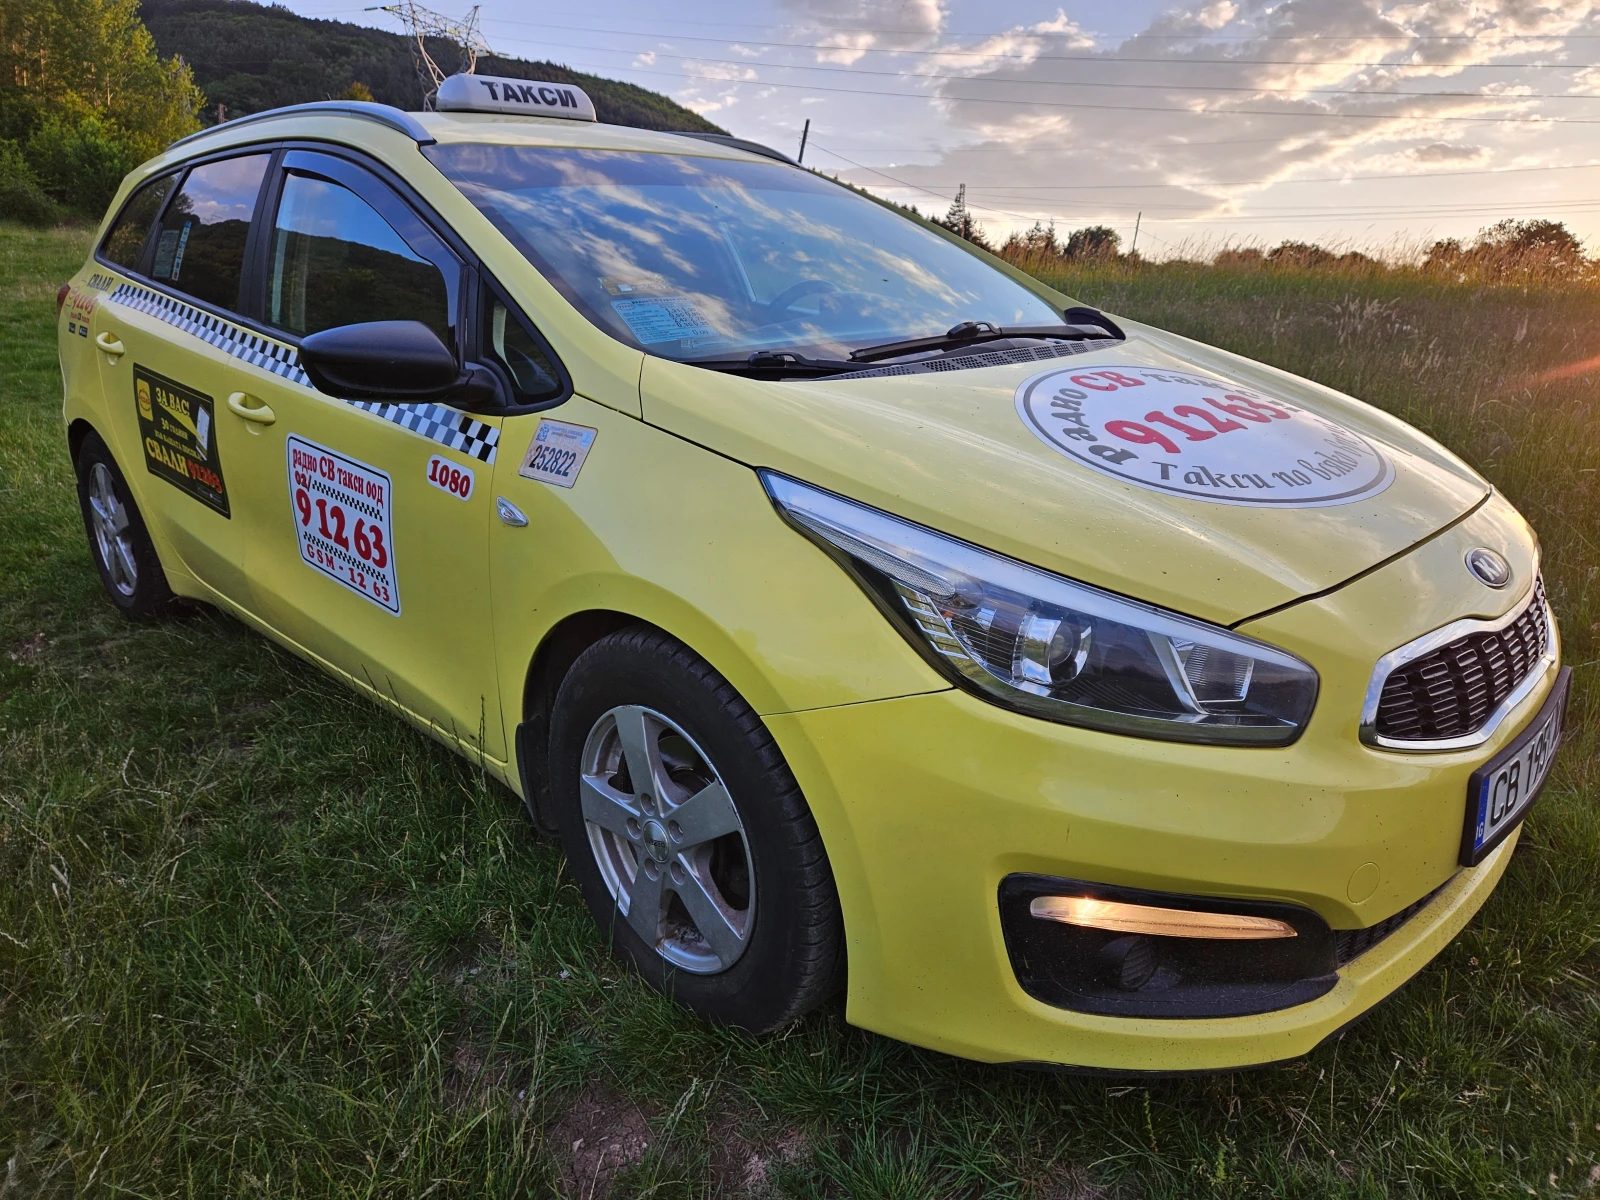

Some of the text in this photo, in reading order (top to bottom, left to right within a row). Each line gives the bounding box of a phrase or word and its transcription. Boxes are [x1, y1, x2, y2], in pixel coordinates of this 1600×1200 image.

[480, 80, 578, 109] ТАКСИ
[1070, 371, 1146, 391] СВ
[155, 387, 169, 408] ЗА
[169, 393, 190, 416] ВАС!
[1105, 394, 1291, 454] 91263
[145, 436, 190, 477] СВАЛИ
[529, 444, 577, 478] 252822
[1151, 461, 1276, 489] Такси
[1272, 468, 1313, 488] по
[1297, 450, 1359, 481] всяко
[292, 448, 384, 509] радио СВ такси оод
[428, 459, 471, 498] 1080
[306, 543, 336, 571] GSM
[348, 567, 367, 590] 12
[372, 581, 391, 602] 63
[1490, 757, 1521, 828] CB
